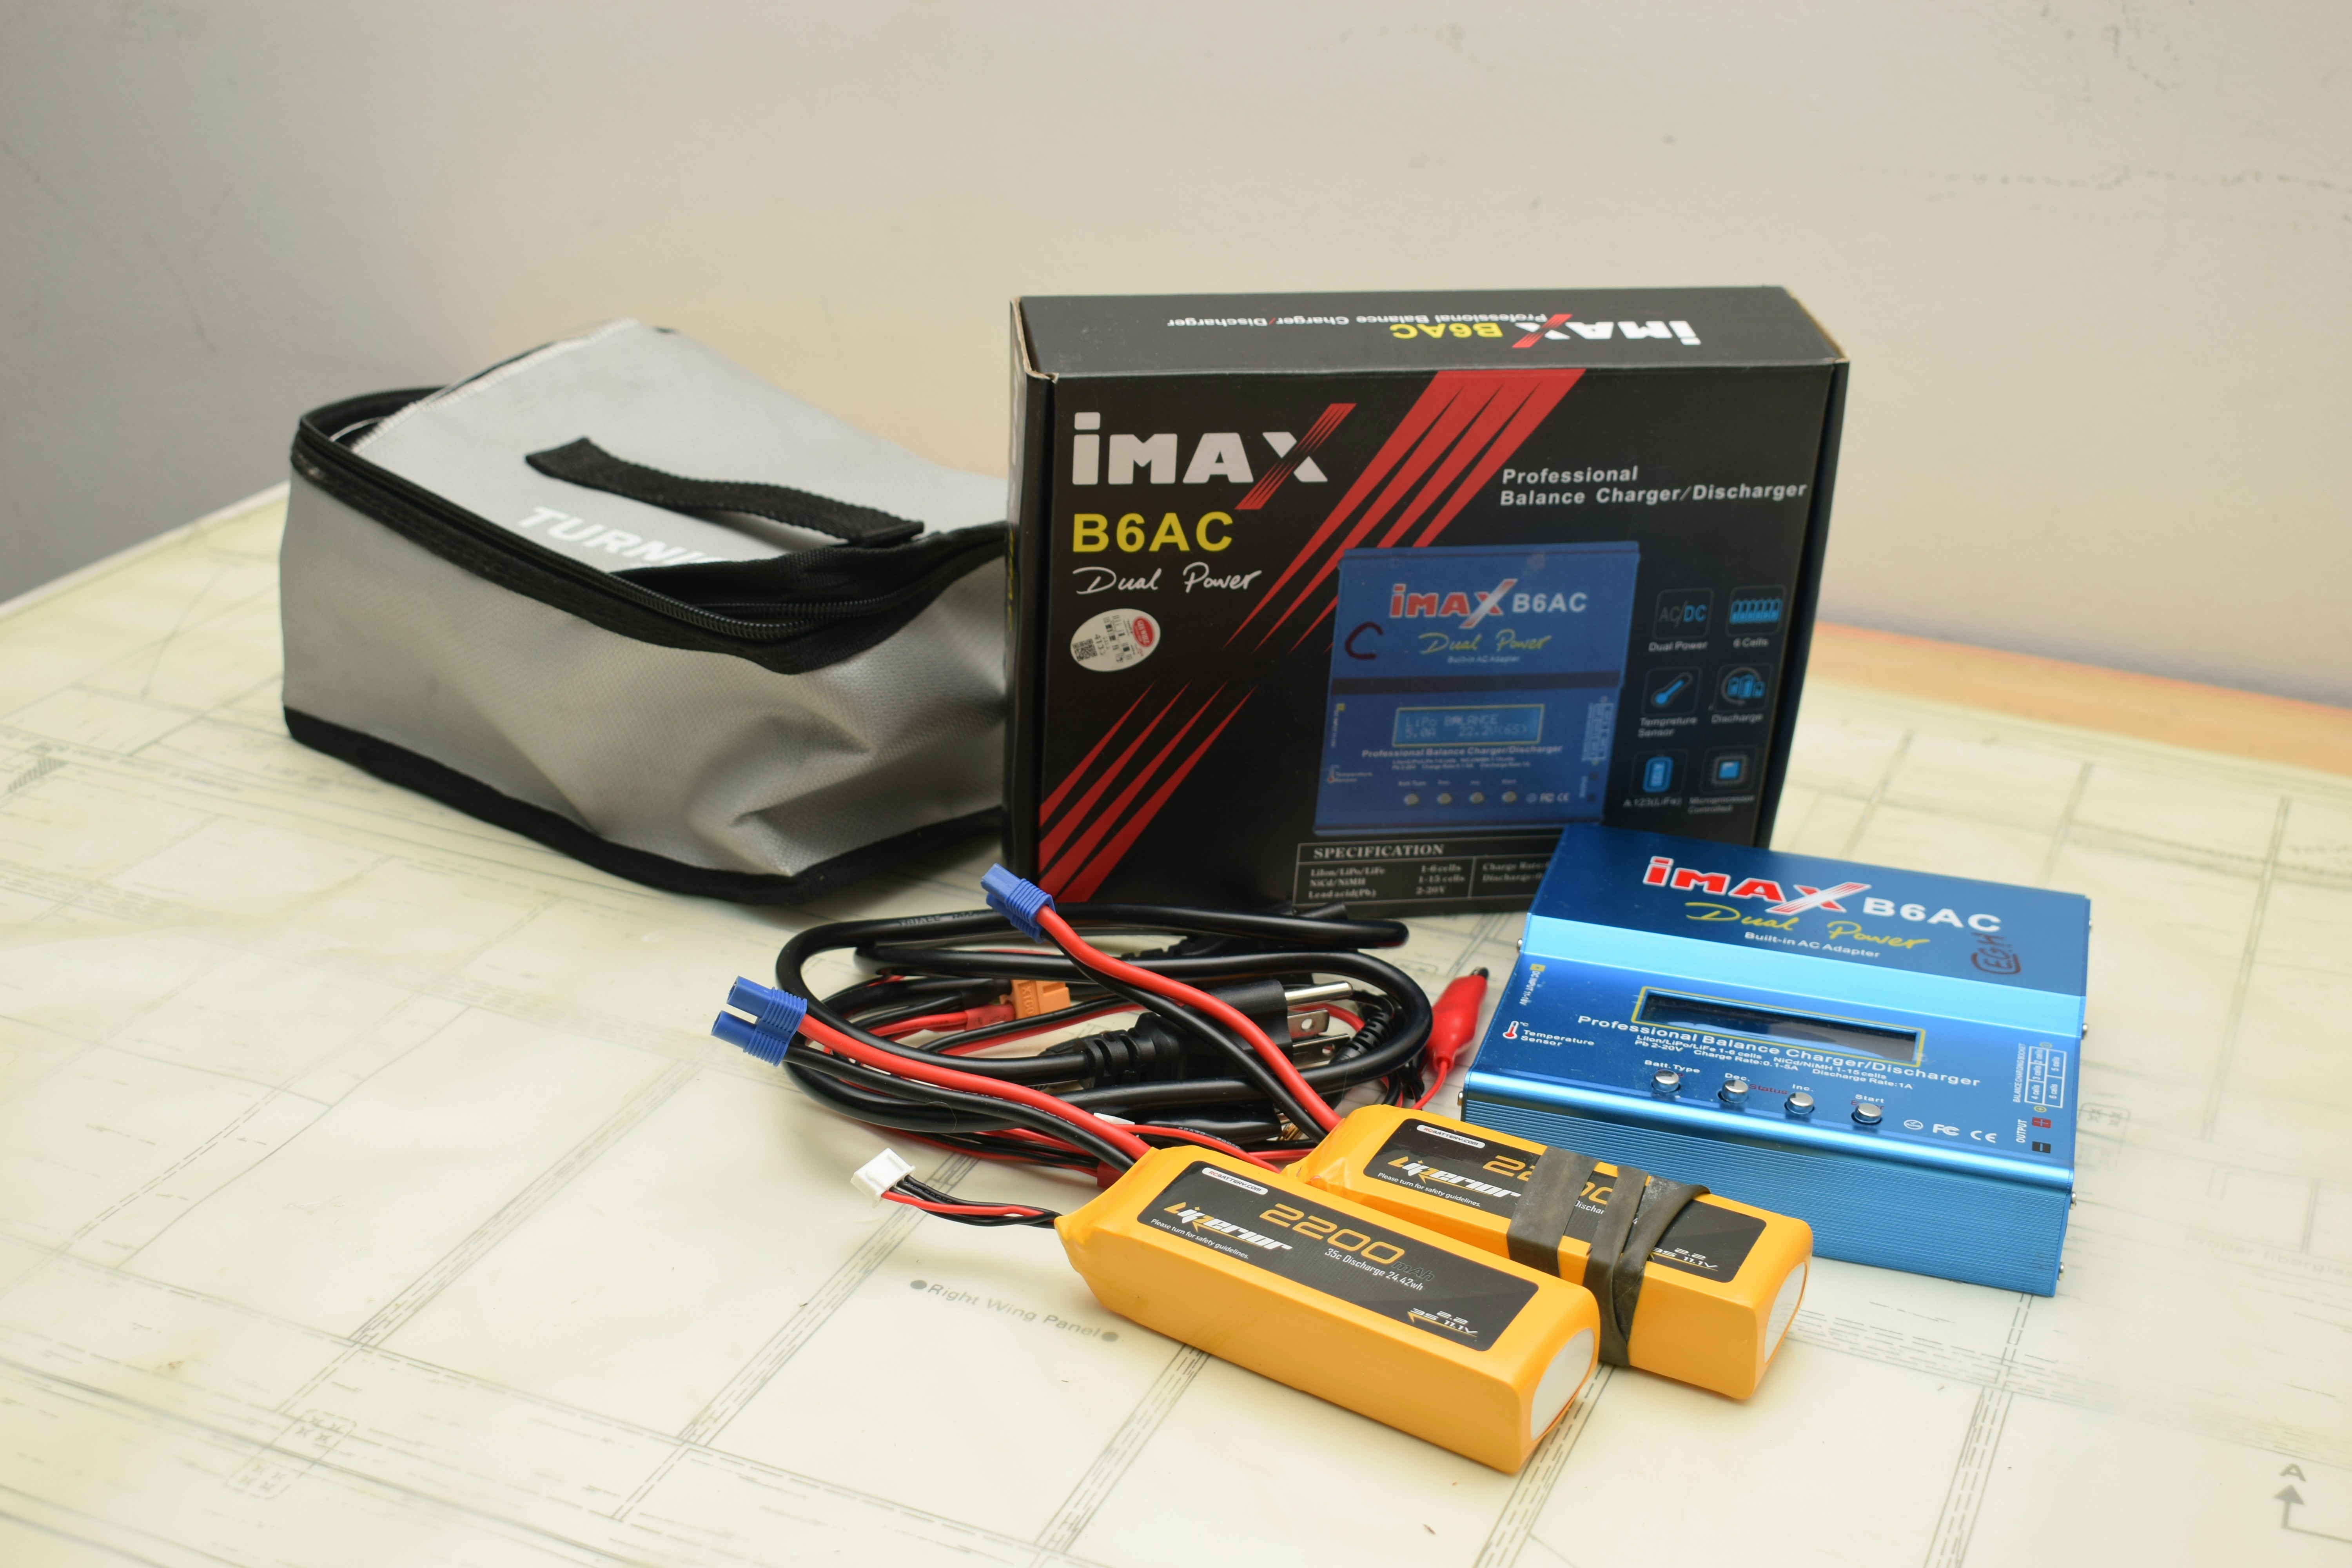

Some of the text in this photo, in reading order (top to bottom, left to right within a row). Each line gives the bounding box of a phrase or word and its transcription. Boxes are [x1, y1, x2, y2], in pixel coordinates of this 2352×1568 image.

[1167, 313, 1548, 327] Professional Balance Charger/Discharger
[1390, 323, 1503, 339] B6AC
[1502, 466, 1639, 485] Professional
[1501, 483, 1807, 506] Balance Charger/Discharger
[517, 506, 728, 567] TURNI
[1073, 511, 1234, 552] B6AC
[1073, 561, 1262, 595] Dual Power
[1512, 592, 1588, 613] B6AC
[1418, 628, 1552, 654] Dual Power
[1648, 641, 1708, 652] Dual Power
[1733, 638, 1740, 649] 6
[1711, 714, 1764, 724] Discharge
[1361, 748, 1424, 758] Professional
[1426, 747, 1465, 756] Balance
[1314, 843, 1445, 859] SPECIFICATION
[1862, 897, 2001, 933] B6AC
[1685, 902, 1931, 951] Dual Power
[1744, 931, 1880, 960] Built-in AC Adapter
[1521, 1035, 1562, 1046] Sensor
[1523, 1029, 1595, 1046] Temperature
[1578, 1015, 1980, 1087] Professional Balance Charger/Discharger
[1635, 1040, 1649, 1048] Pb
[1651, 1042, 1684, 1052] 2-20V
[1694, 1049, 1732, 1061] Charge
[1812, 1068, 1866, 1082] Discharge
[1869, 1077, 1913, 1089] Rate:1A
[1673, 1064, 1700, 1074] Type
[1737, 1051, 1762, 1060] cells
[1773, 1056, 1833, 1071] NiCd/NiMH
[1861, 1071, 1886, 1080] cells
[2033, 1065, 2042, 1075] cells
[2052, 1056, 2060, 1067] cells
[1724, 1073, 1750, 1082] Dec.
[1792, 1083, 1814, 1092] Inc.
[1748, 1083, 1788, 1095] Status
[1855, 1093, 1885, 1103] Start
[2013, 1082, 2022, 1103] BALANCE
[2031, 1084, 2040, 1095] cells
[2049, 1083, 2058, 1094] cells
[2015, 1119, 2027, 1143] OUTPUT
[1377, 1172, 1399, 1183] Please
[1399, 1179, 1414, 1187] turn
[1425, 1186, 1446, 1197] safety
[1446, 1192, 1481, 1208] guidelines.
[1151, 1218, 1249, 1259] Please turn for safety guidelines.
[1259, 1203, 1435, 1282] 2200 mAh
[2185, 1231, 2255, 1256] Proper
[1651, 1247, 1719, 1269] 3S 11.1V
[1674, 1247, 1706, 1260] 2.2
[1325, 1248, 1424, 1291] 35c Discharge 24.42wh
[927, 1283, 1101, 1338] Right Wing Panel
[1410, 1307, 1479, 1333] 3S 11.1V
[1436, 1310, 1469, 1325] 2.2
[2279, 1463, 2307, 1482] A
